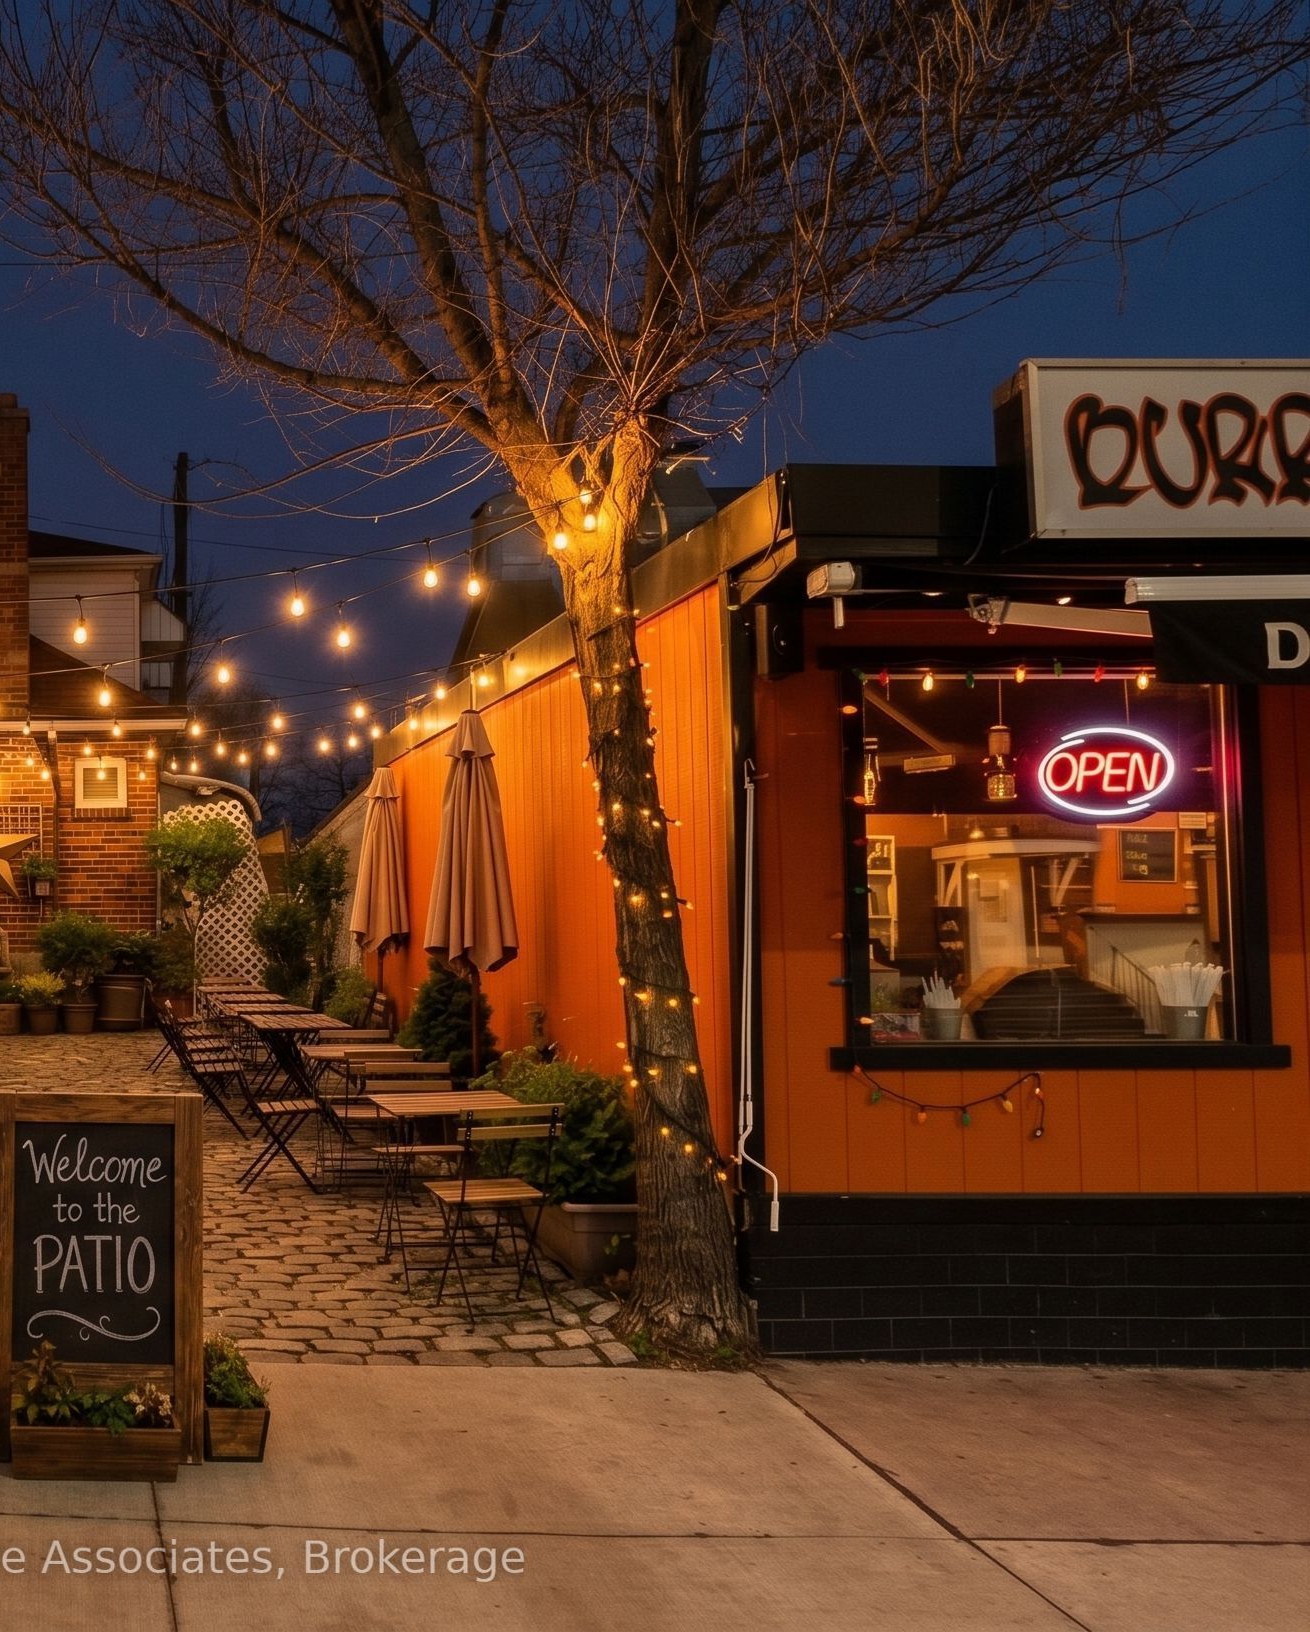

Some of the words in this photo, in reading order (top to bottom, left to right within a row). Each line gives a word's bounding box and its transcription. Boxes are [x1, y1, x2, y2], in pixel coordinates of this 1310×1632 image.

[1264, 622, 1310, 669] D
[1045, 751, 1161, 793] OPEN
[22, 1133, 167, 1188] Welcome
[53, 1193, 83, 1223] to
[93, 1192, 140, 1224] the
[33, 1234, 156, 1294] PATIO
